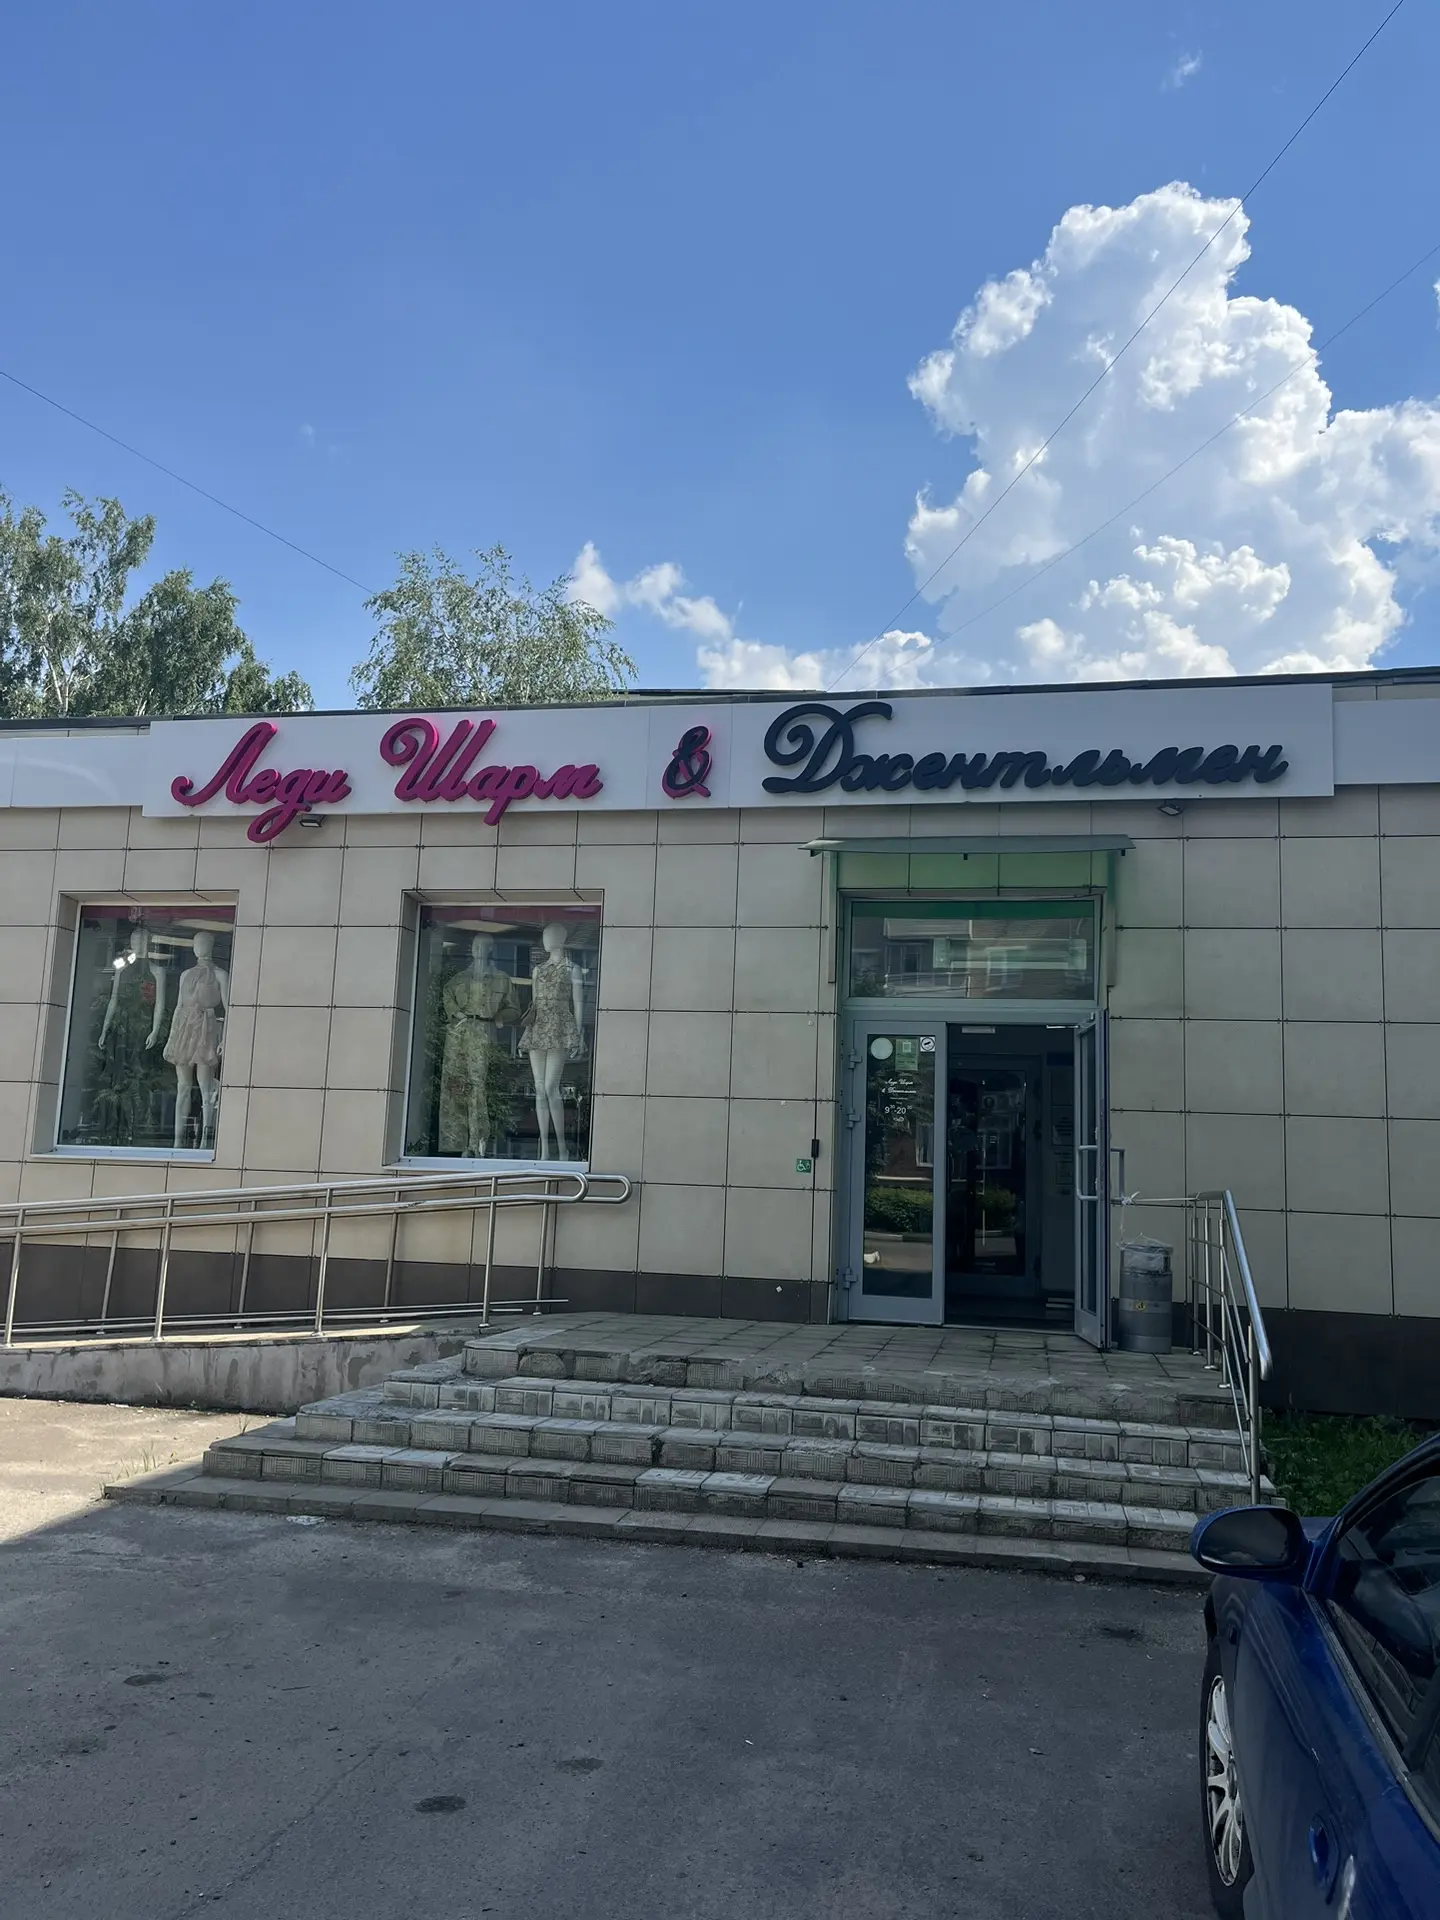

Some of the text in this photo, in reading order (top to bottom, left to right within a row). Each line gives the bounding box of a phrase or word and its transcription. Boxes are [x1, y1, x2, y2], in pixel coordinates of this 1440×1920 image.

[171, 701, 1289, 843] Леди Шарм & Джентльмен
